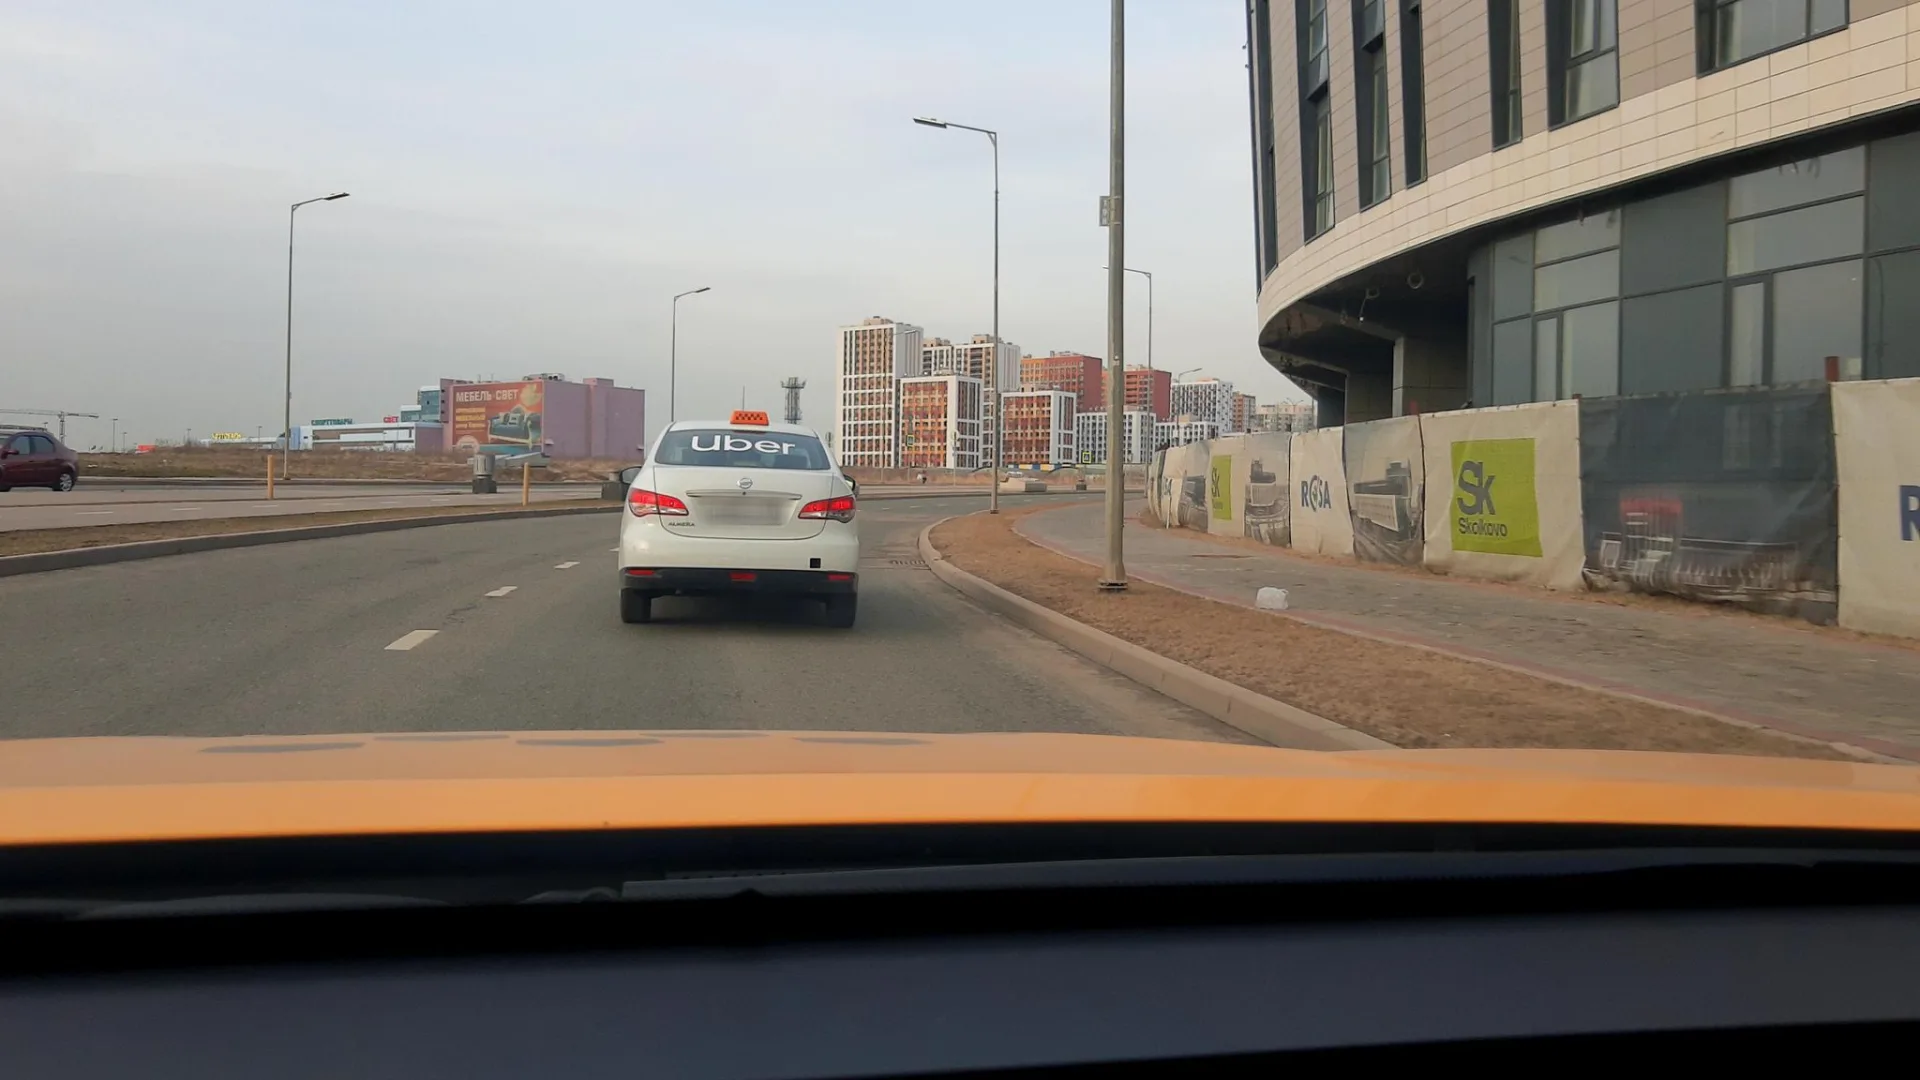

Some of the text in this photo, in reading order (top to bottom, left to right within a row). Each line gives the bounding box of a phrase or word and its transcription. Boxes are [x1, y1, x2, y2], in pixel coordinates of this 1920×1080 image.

[456, 389, 519, 402] МЕБЕЛЬ СВЕТ
[1457, 460, 1496, 516] Sk
[1458, 517, 1508, 537] Skolkovo
